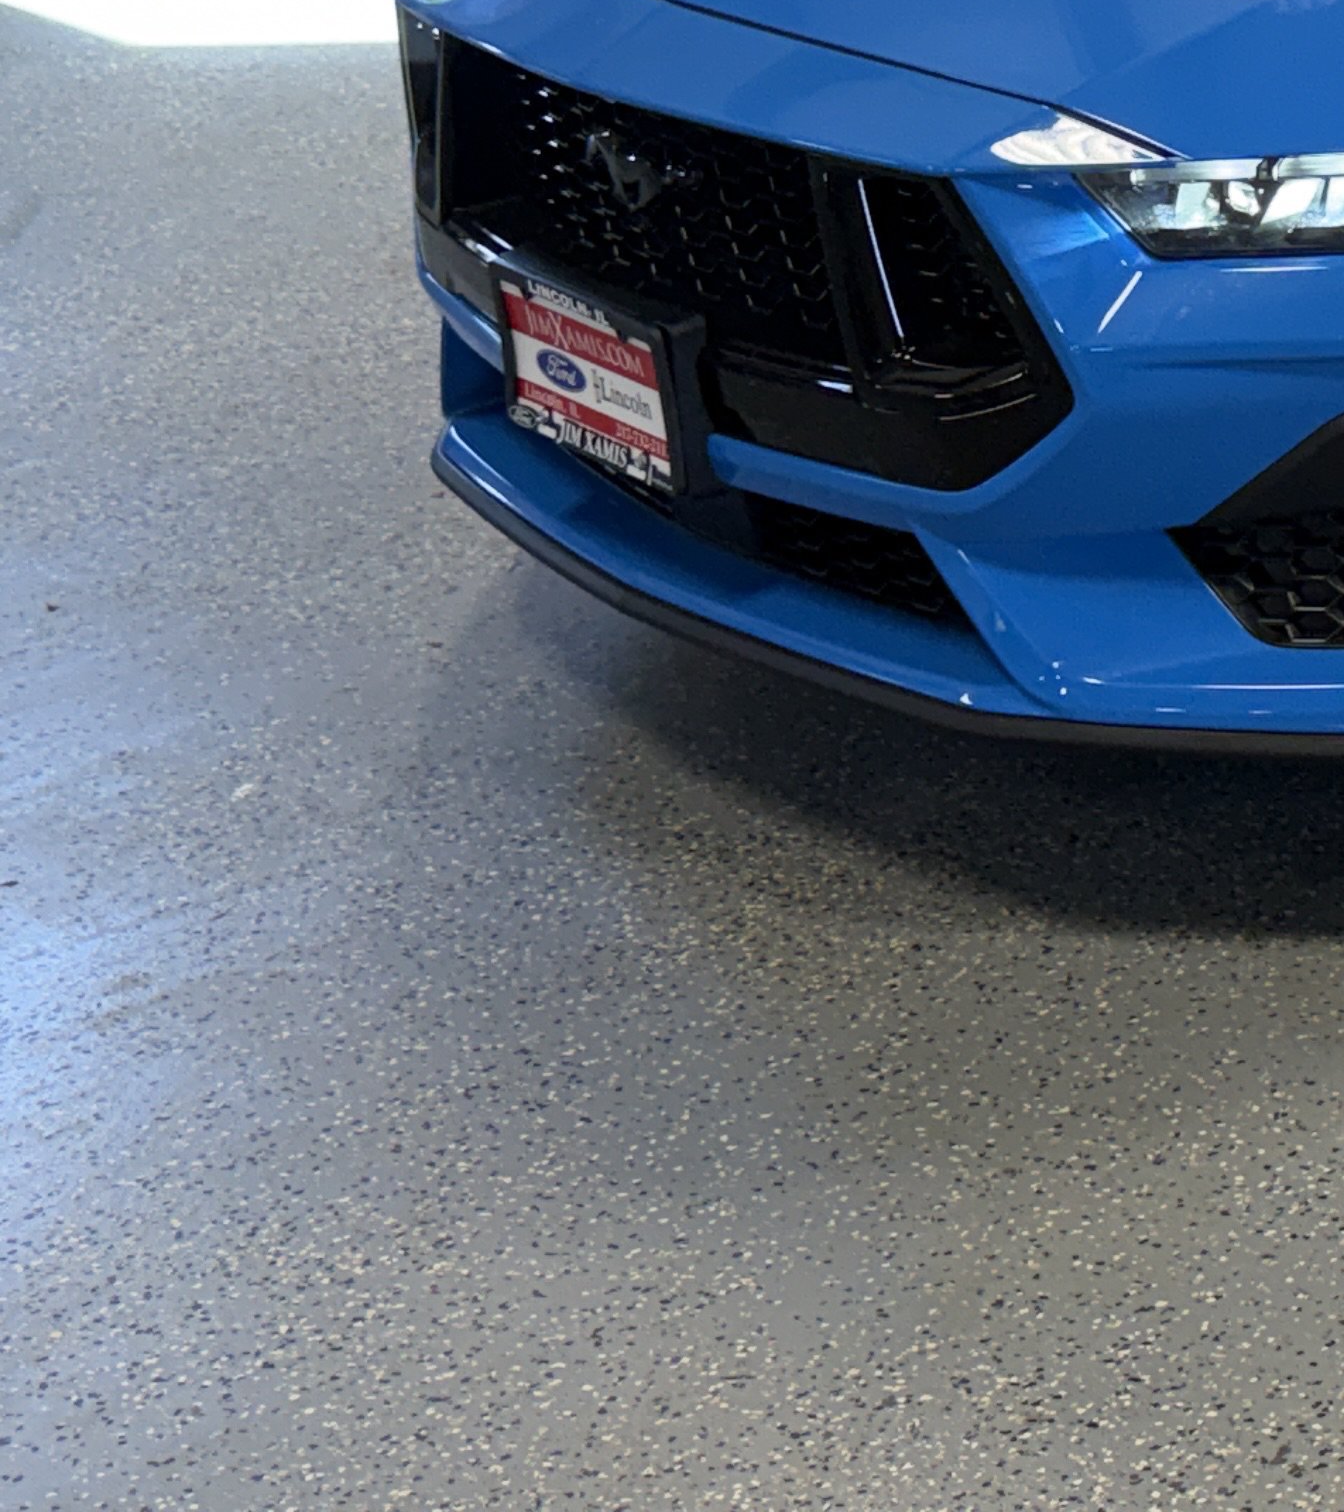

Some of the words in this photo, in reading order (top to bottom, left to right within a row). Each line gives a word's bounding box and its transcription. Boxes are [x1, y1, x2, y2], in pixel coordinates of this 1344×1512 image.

[547, 353, 578, 387] Ford
[600, 375, 653, 420] Lincoln
[583, 429, 629, 468] XAMIS
